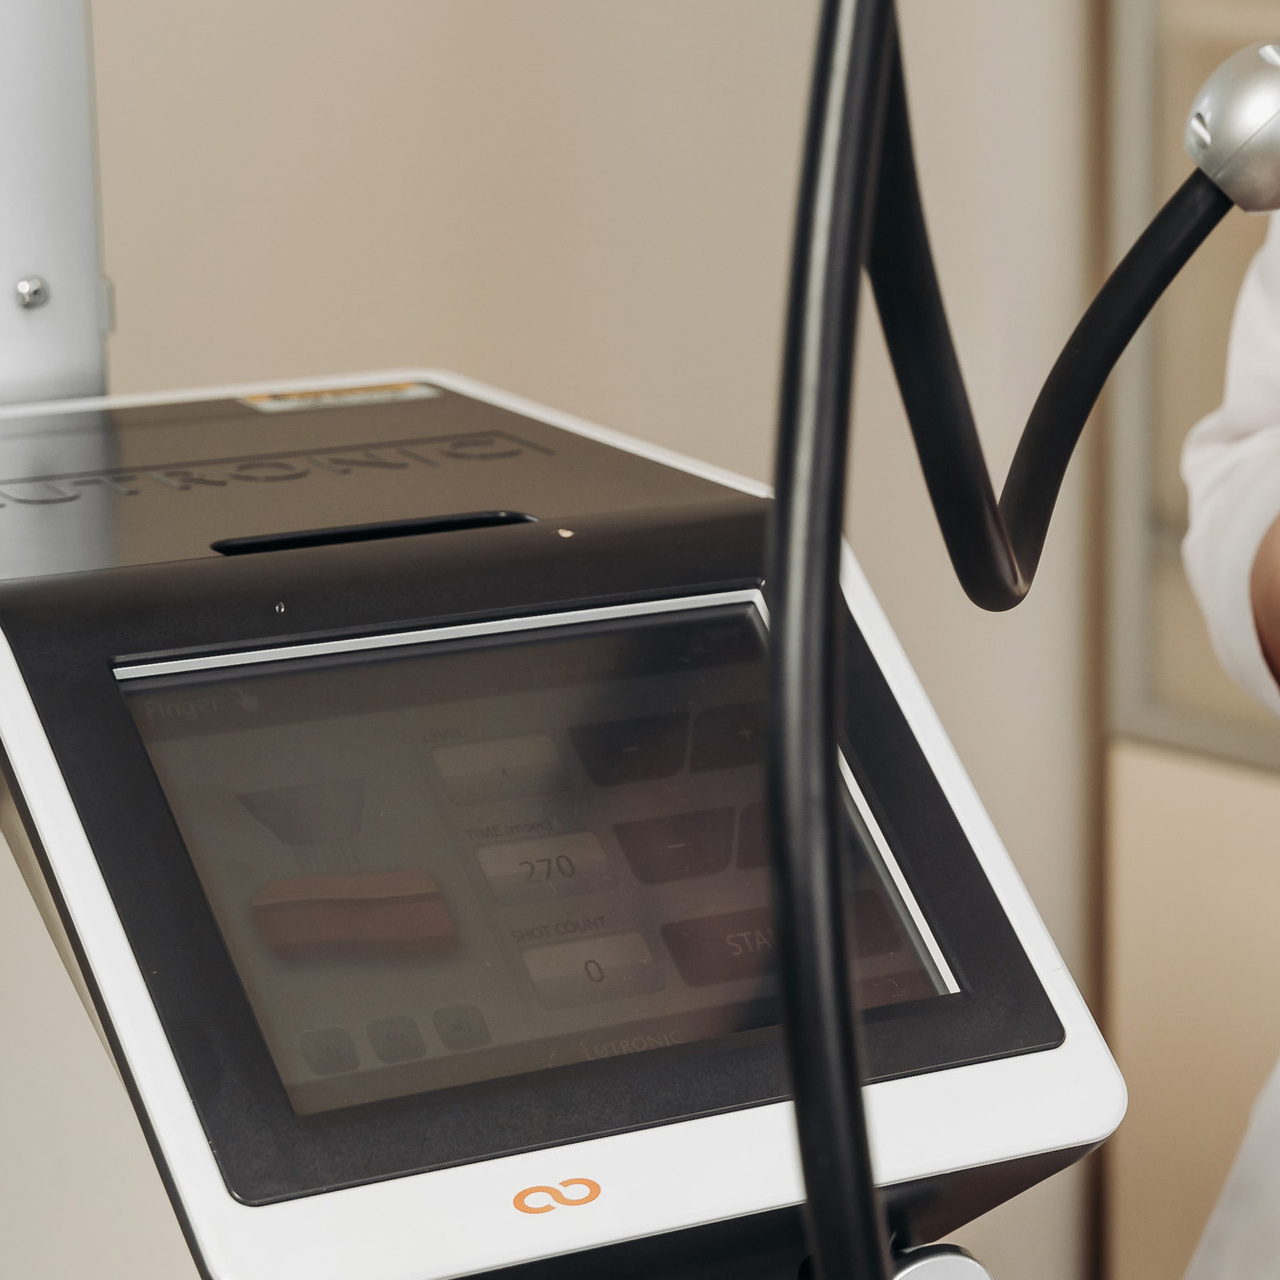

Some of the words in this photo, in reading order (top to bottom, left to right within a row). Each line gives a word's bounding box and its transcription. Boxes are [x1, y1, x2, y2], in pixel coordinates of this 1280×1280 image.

[0, 438, 522, 509] UTRONIC
[519, 854, 576, 884] 270
[510, 924, 550, 944] SHOT
[554, 915, 606, 936] COUNT
[725, 927, 772, 957] STA
